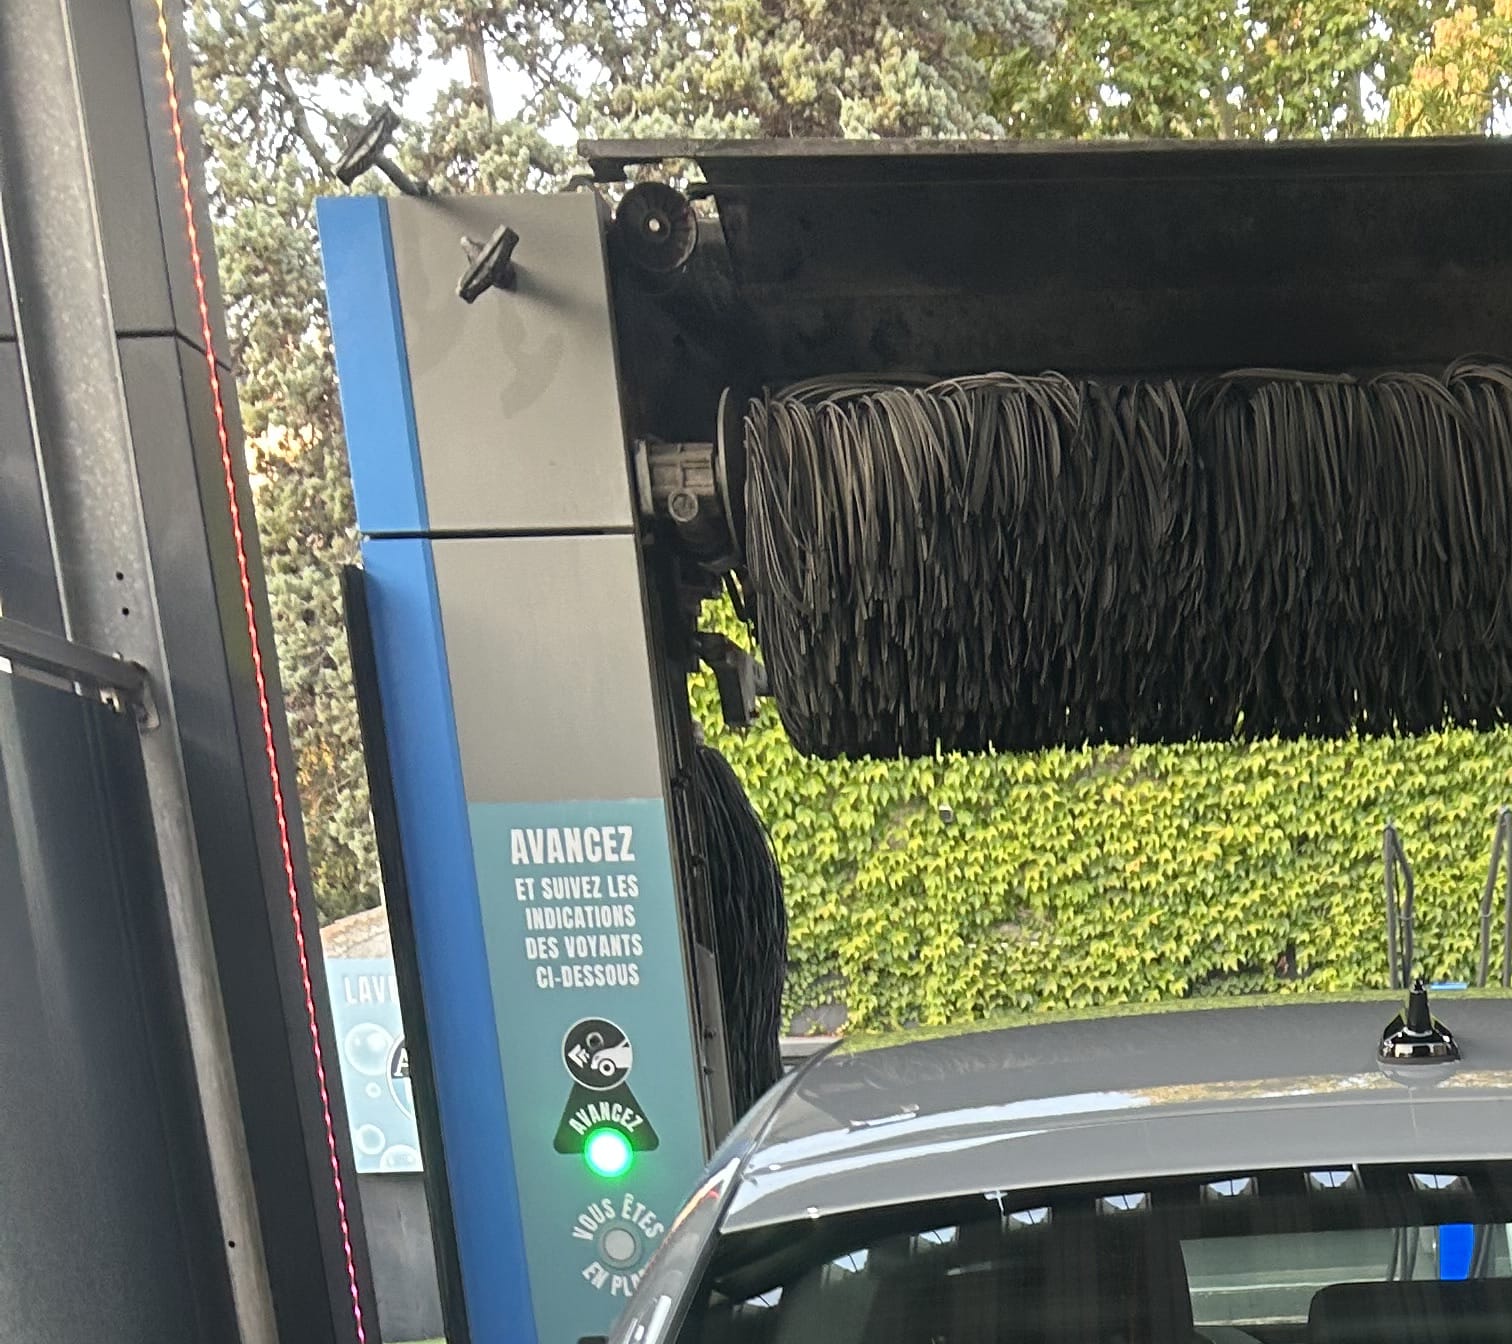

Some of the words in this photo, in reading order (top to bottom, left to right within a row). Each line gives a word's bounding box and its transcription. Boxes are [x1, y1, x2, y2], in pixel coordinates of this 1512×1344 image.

[511, 825, 636, 865] AVANCEZ
[515, 877, 535, 901] ET
[541, 875, 602, 900] SUIVEZ
[607, 874, 639, 898] LES
[525, 904, 636, 930] INDICATIONS
[525, 936, 559, 960] DES
[564, 934, 644, 958] VOYANTS
[536, 963, 640, 989] CI-DESSOUS
[568, 1101, 644, 1135] AVANCEZ
[572, 1198, 616, 1241] VOUS
[621, 1193, 665, 1239] ÊTES
[582, 1261, 611, 1290] EN
